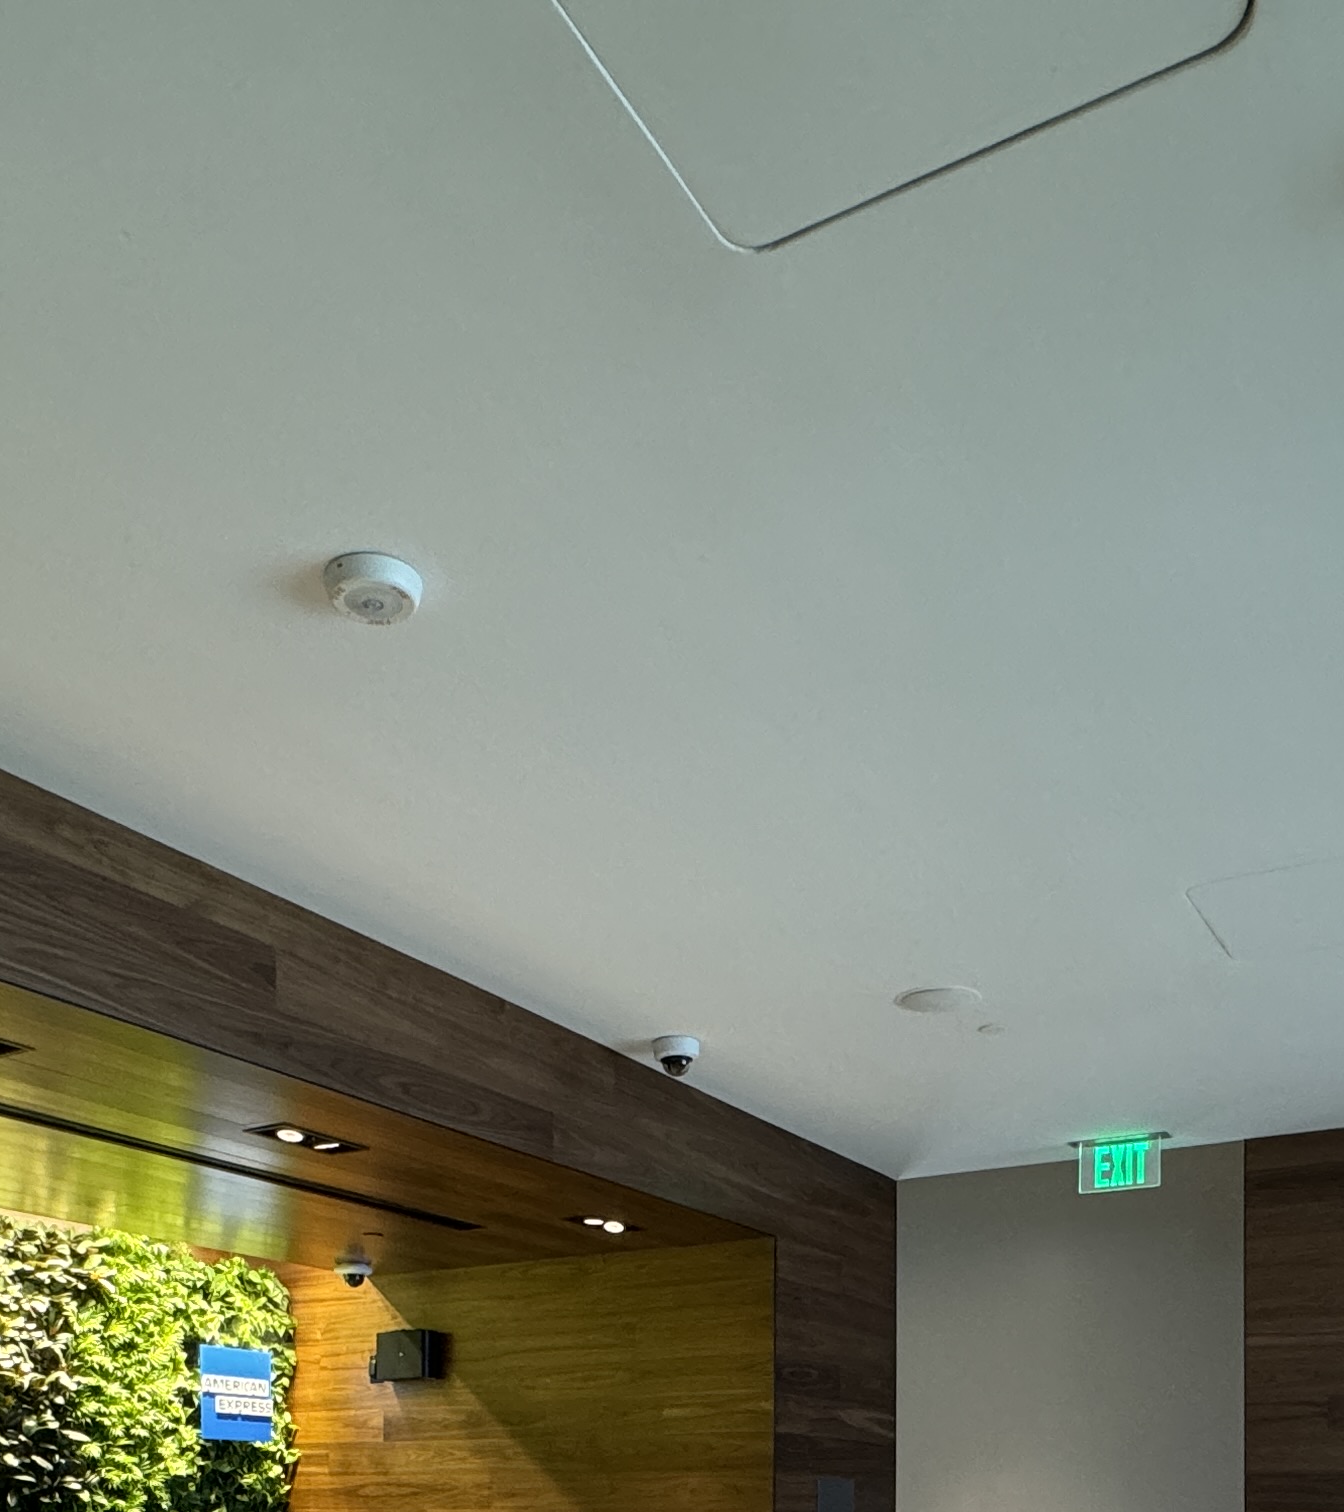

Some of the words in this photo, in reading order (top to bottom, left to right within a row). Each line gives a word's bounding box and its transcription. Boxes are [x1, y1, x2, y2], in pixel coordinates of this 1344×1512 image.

[1094, 1142, 1149, 1188] EXIT
[204, 1377, 267, 1393] AMERICAN
[219, 1398, 272, 1414] EXPRESS
